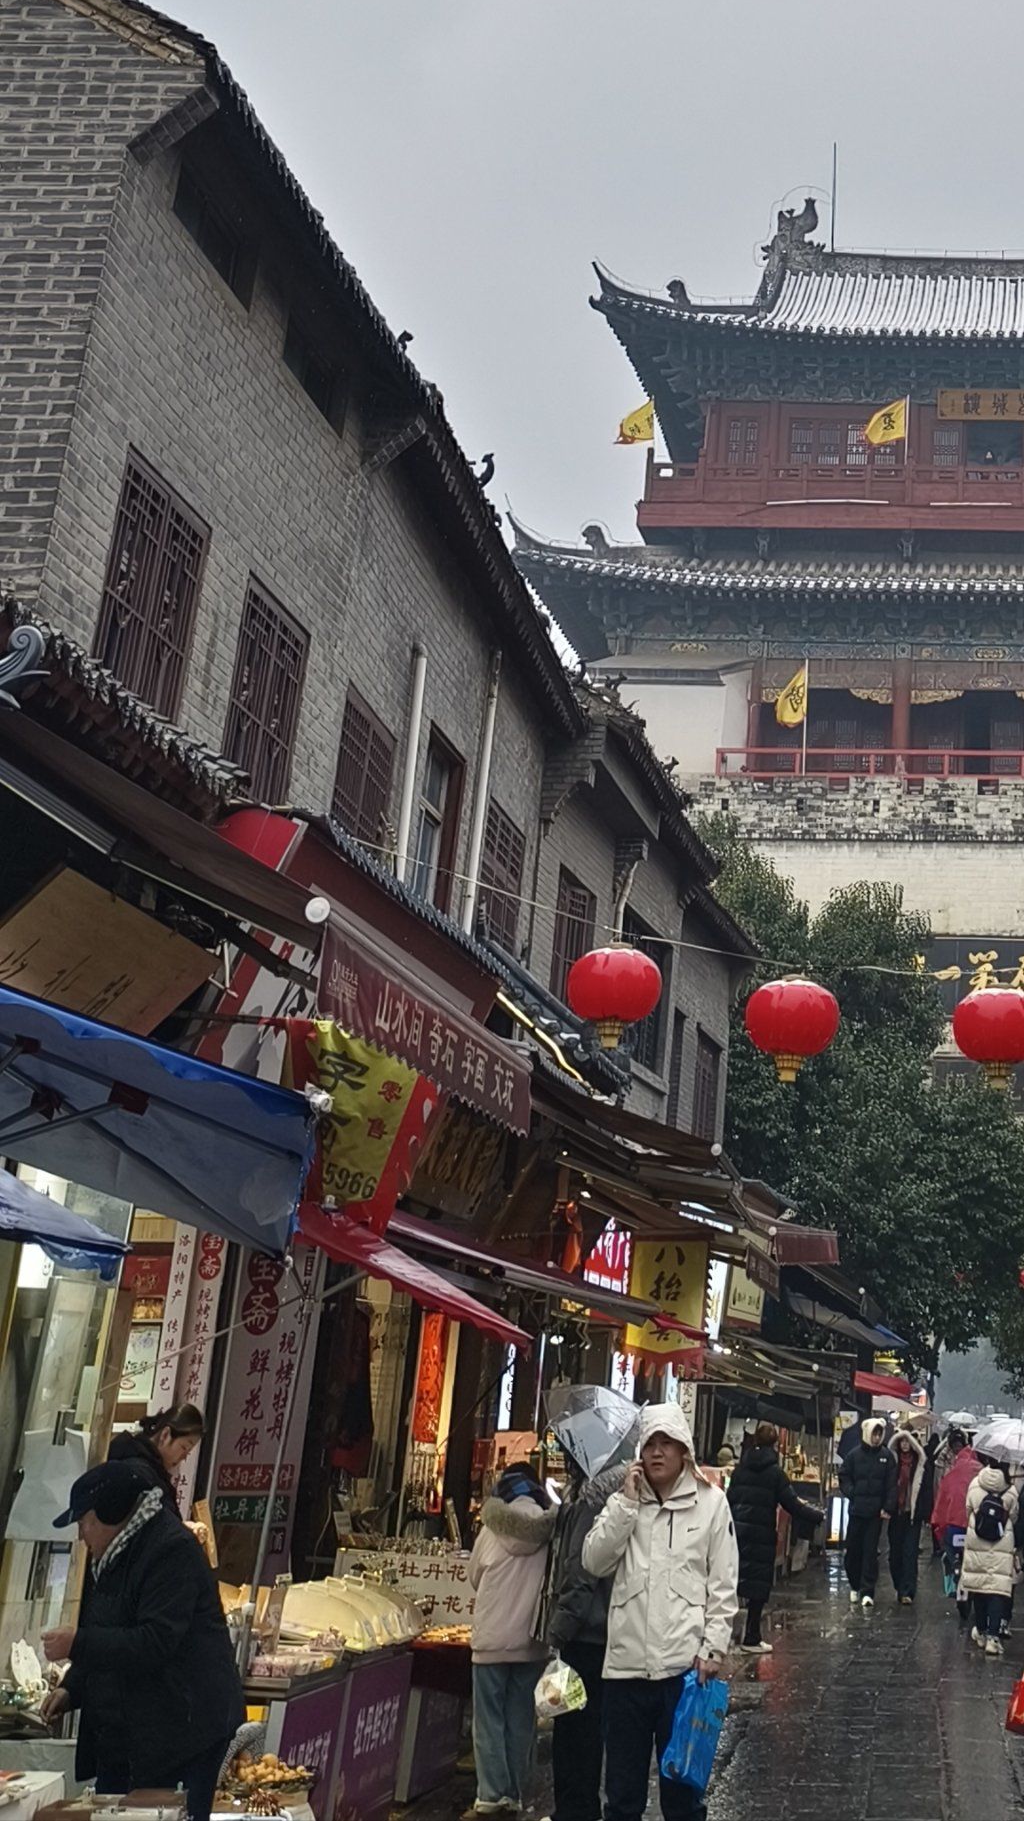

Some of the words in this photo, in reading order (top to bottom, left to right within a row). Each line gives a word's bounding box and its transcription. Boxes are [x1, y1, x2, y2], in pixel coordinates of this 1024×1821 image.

[375, 981, 424, 1057] 山水间
[429, 1017, 458, 1074] 奇石
[461, 1039, 489, 1094] 字画
[169, 1234, 192, 1304] 洛阳特产
[234, 1349, 270, 1461] 鲜花饼
